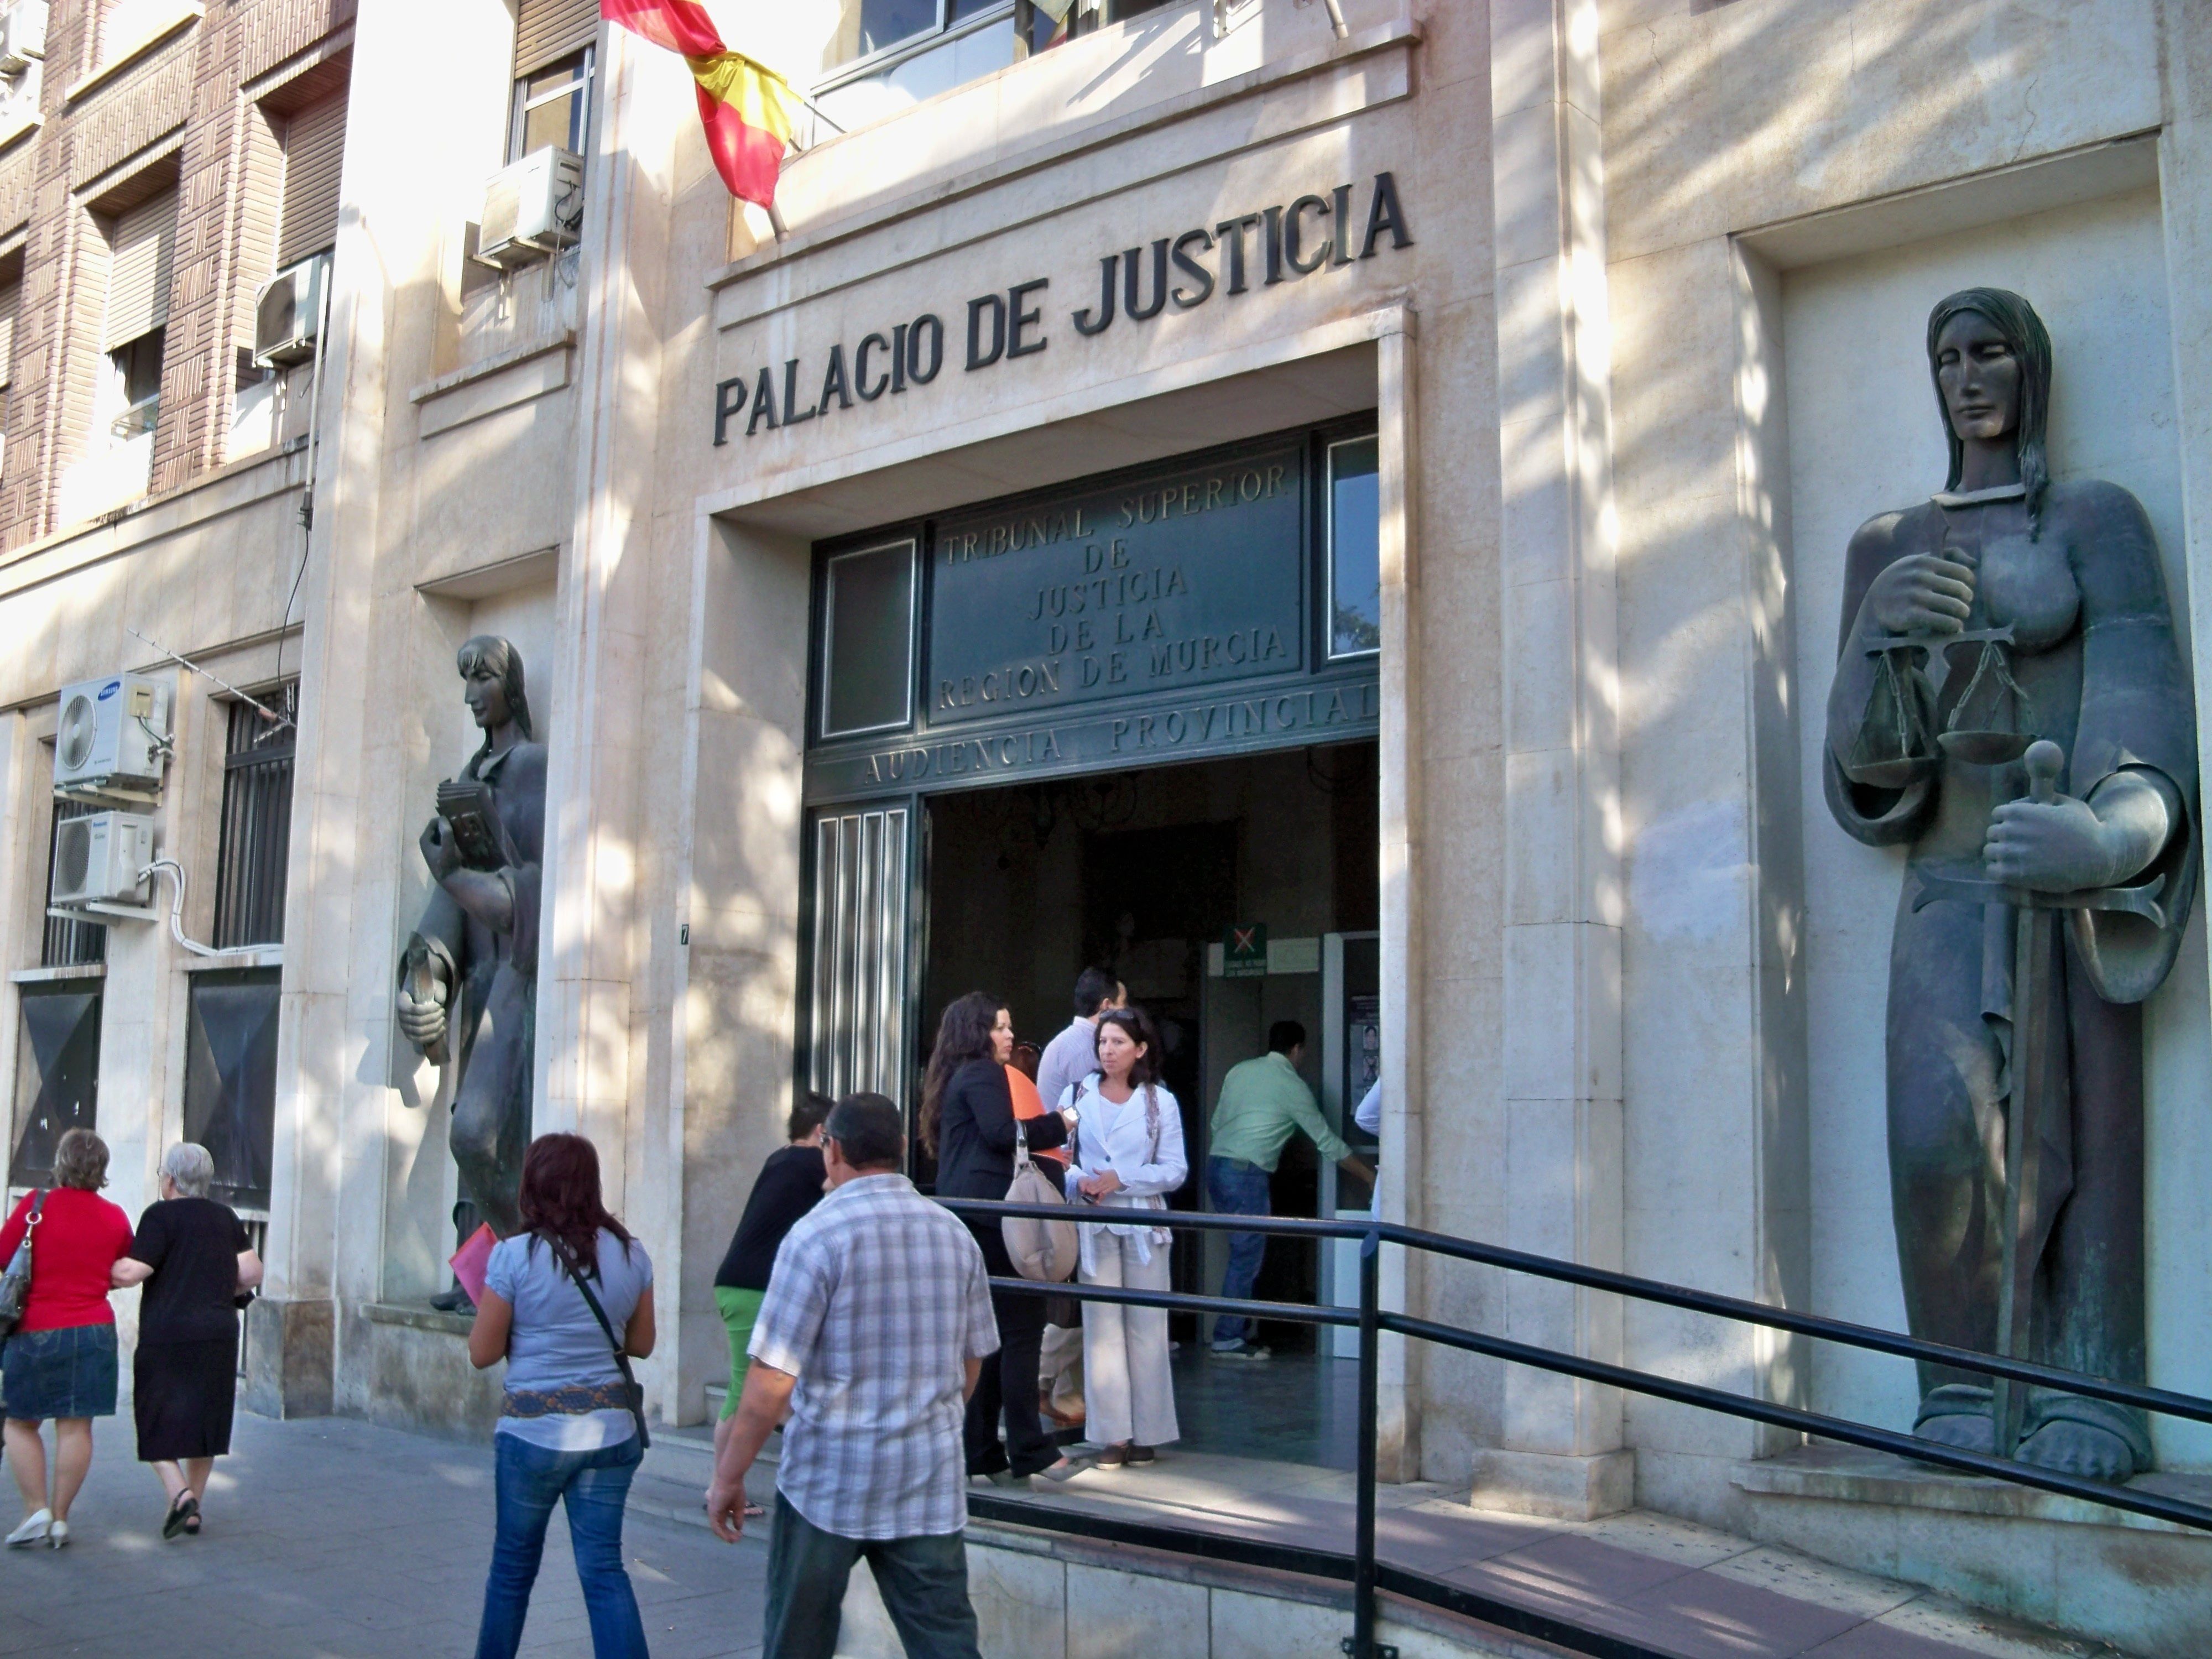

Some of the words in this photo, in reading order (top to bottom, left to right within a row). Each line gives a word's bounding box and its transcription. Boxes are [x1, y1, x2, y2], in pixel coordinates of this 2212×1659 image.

[713, 313, 943, 447] PALACIO
[964, 278, 1049, 372] DE
[1071, 171, 1414, 336] JUSTICIA
[944, 508, 1095, 566] TRIBUNAL
[1117, 466, 1286, 529] SUPERIOR
[1027, 562, 1188, 620] JUSTICIA
[1082, 538, 1131, 575] DE
[938, 660, 1060, 711] REGION
[1079, 651, 1128, 688] DE
[1149, 624, 1287, 678] MURCIA
[1048, 620, 1095, 657] DE
[1114, 608, 1165, 645] LA
[864, 729, 1062, 785] AUDIENCIA
[1111, 684, 1380, 753] PROVINCIAL
[682, 925, 688, 943] 7
